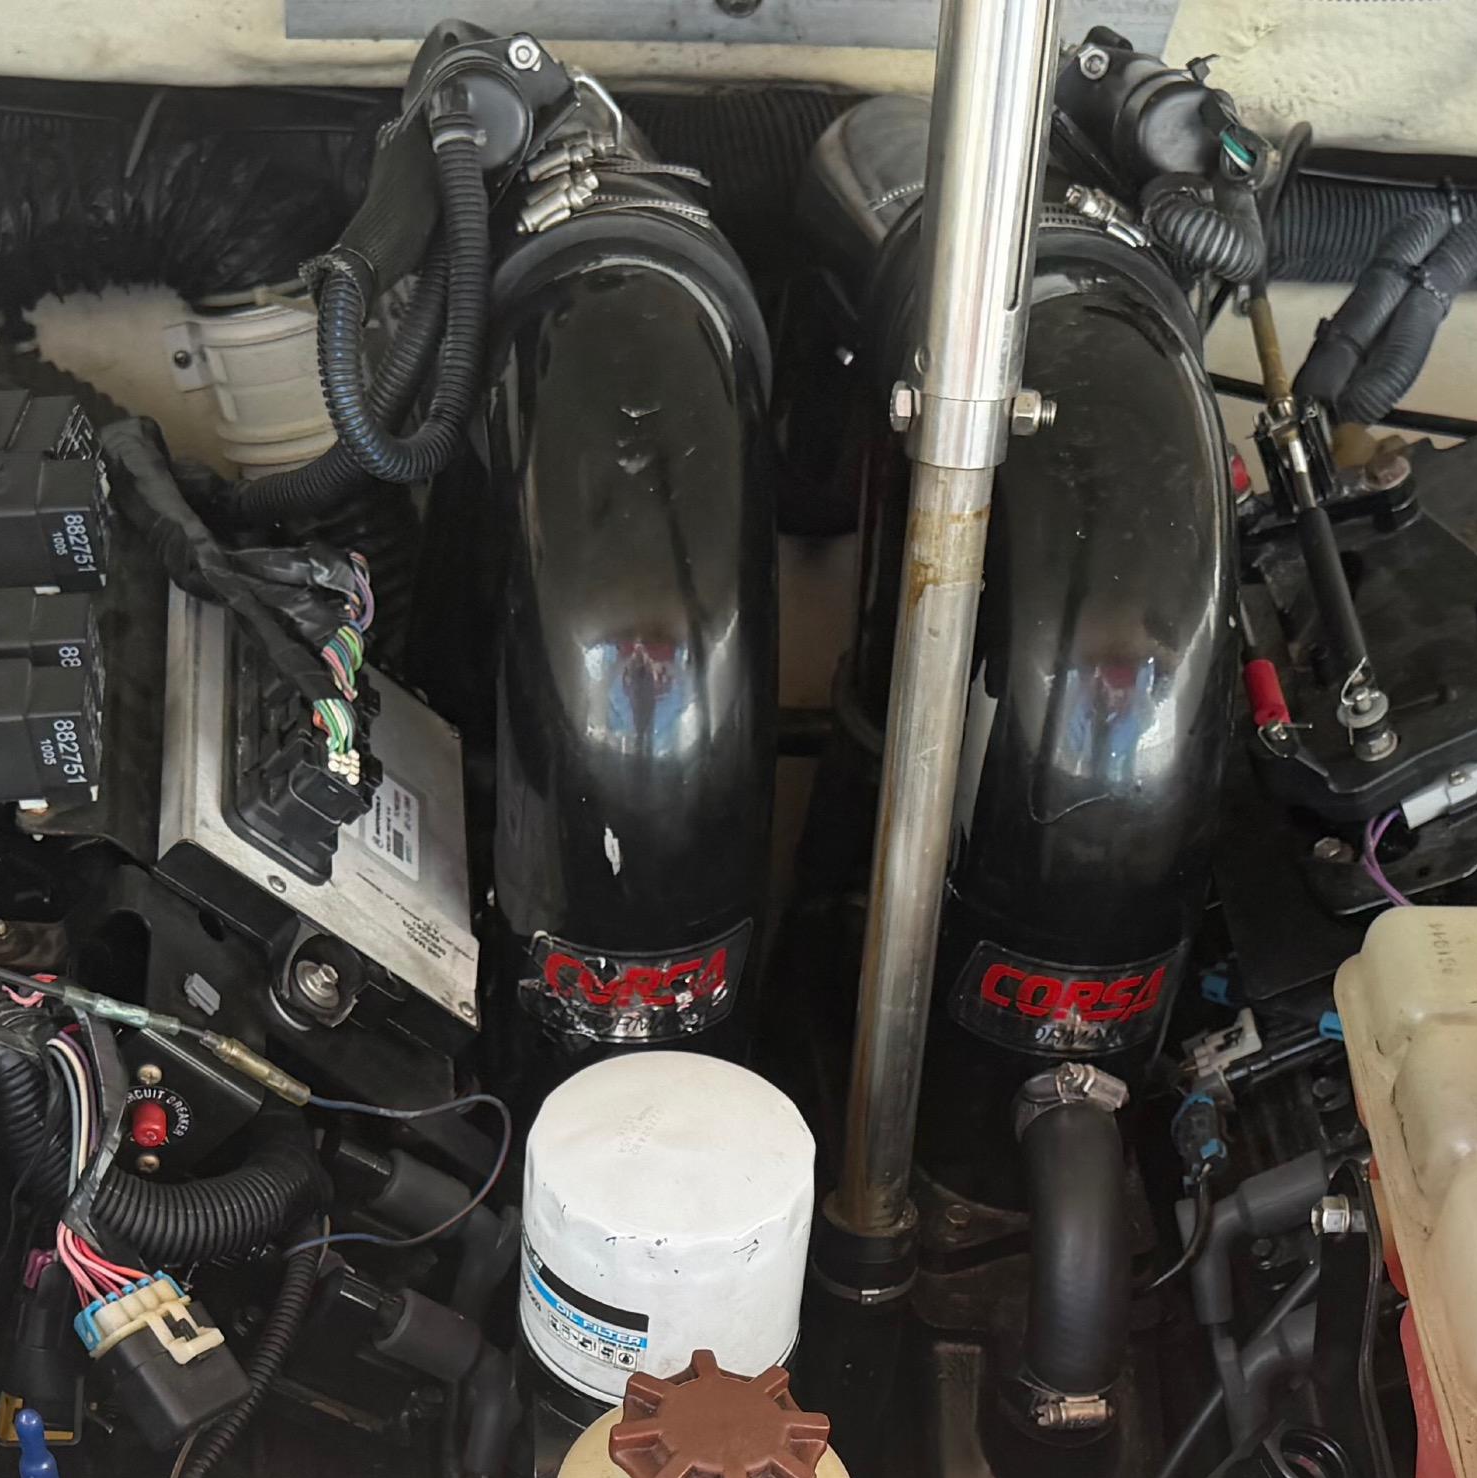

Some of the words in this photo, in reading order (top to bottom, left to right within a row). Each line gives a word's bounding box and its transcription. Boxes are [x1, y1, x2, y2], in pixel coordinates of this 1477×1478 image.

[52, 531, 67, 556] 1005
[64, 514, 97, 572] 882751
[41, 739, 56, 765] 1005
[54, 720, 87, 784] 882751
[981, 964, 1165, 1023] CORSA
[166, 1096, 189, 1136] BREAKER
[556, 1302, 578, 1322] OIL
[584, 1320, 642, 1346] FILTER
